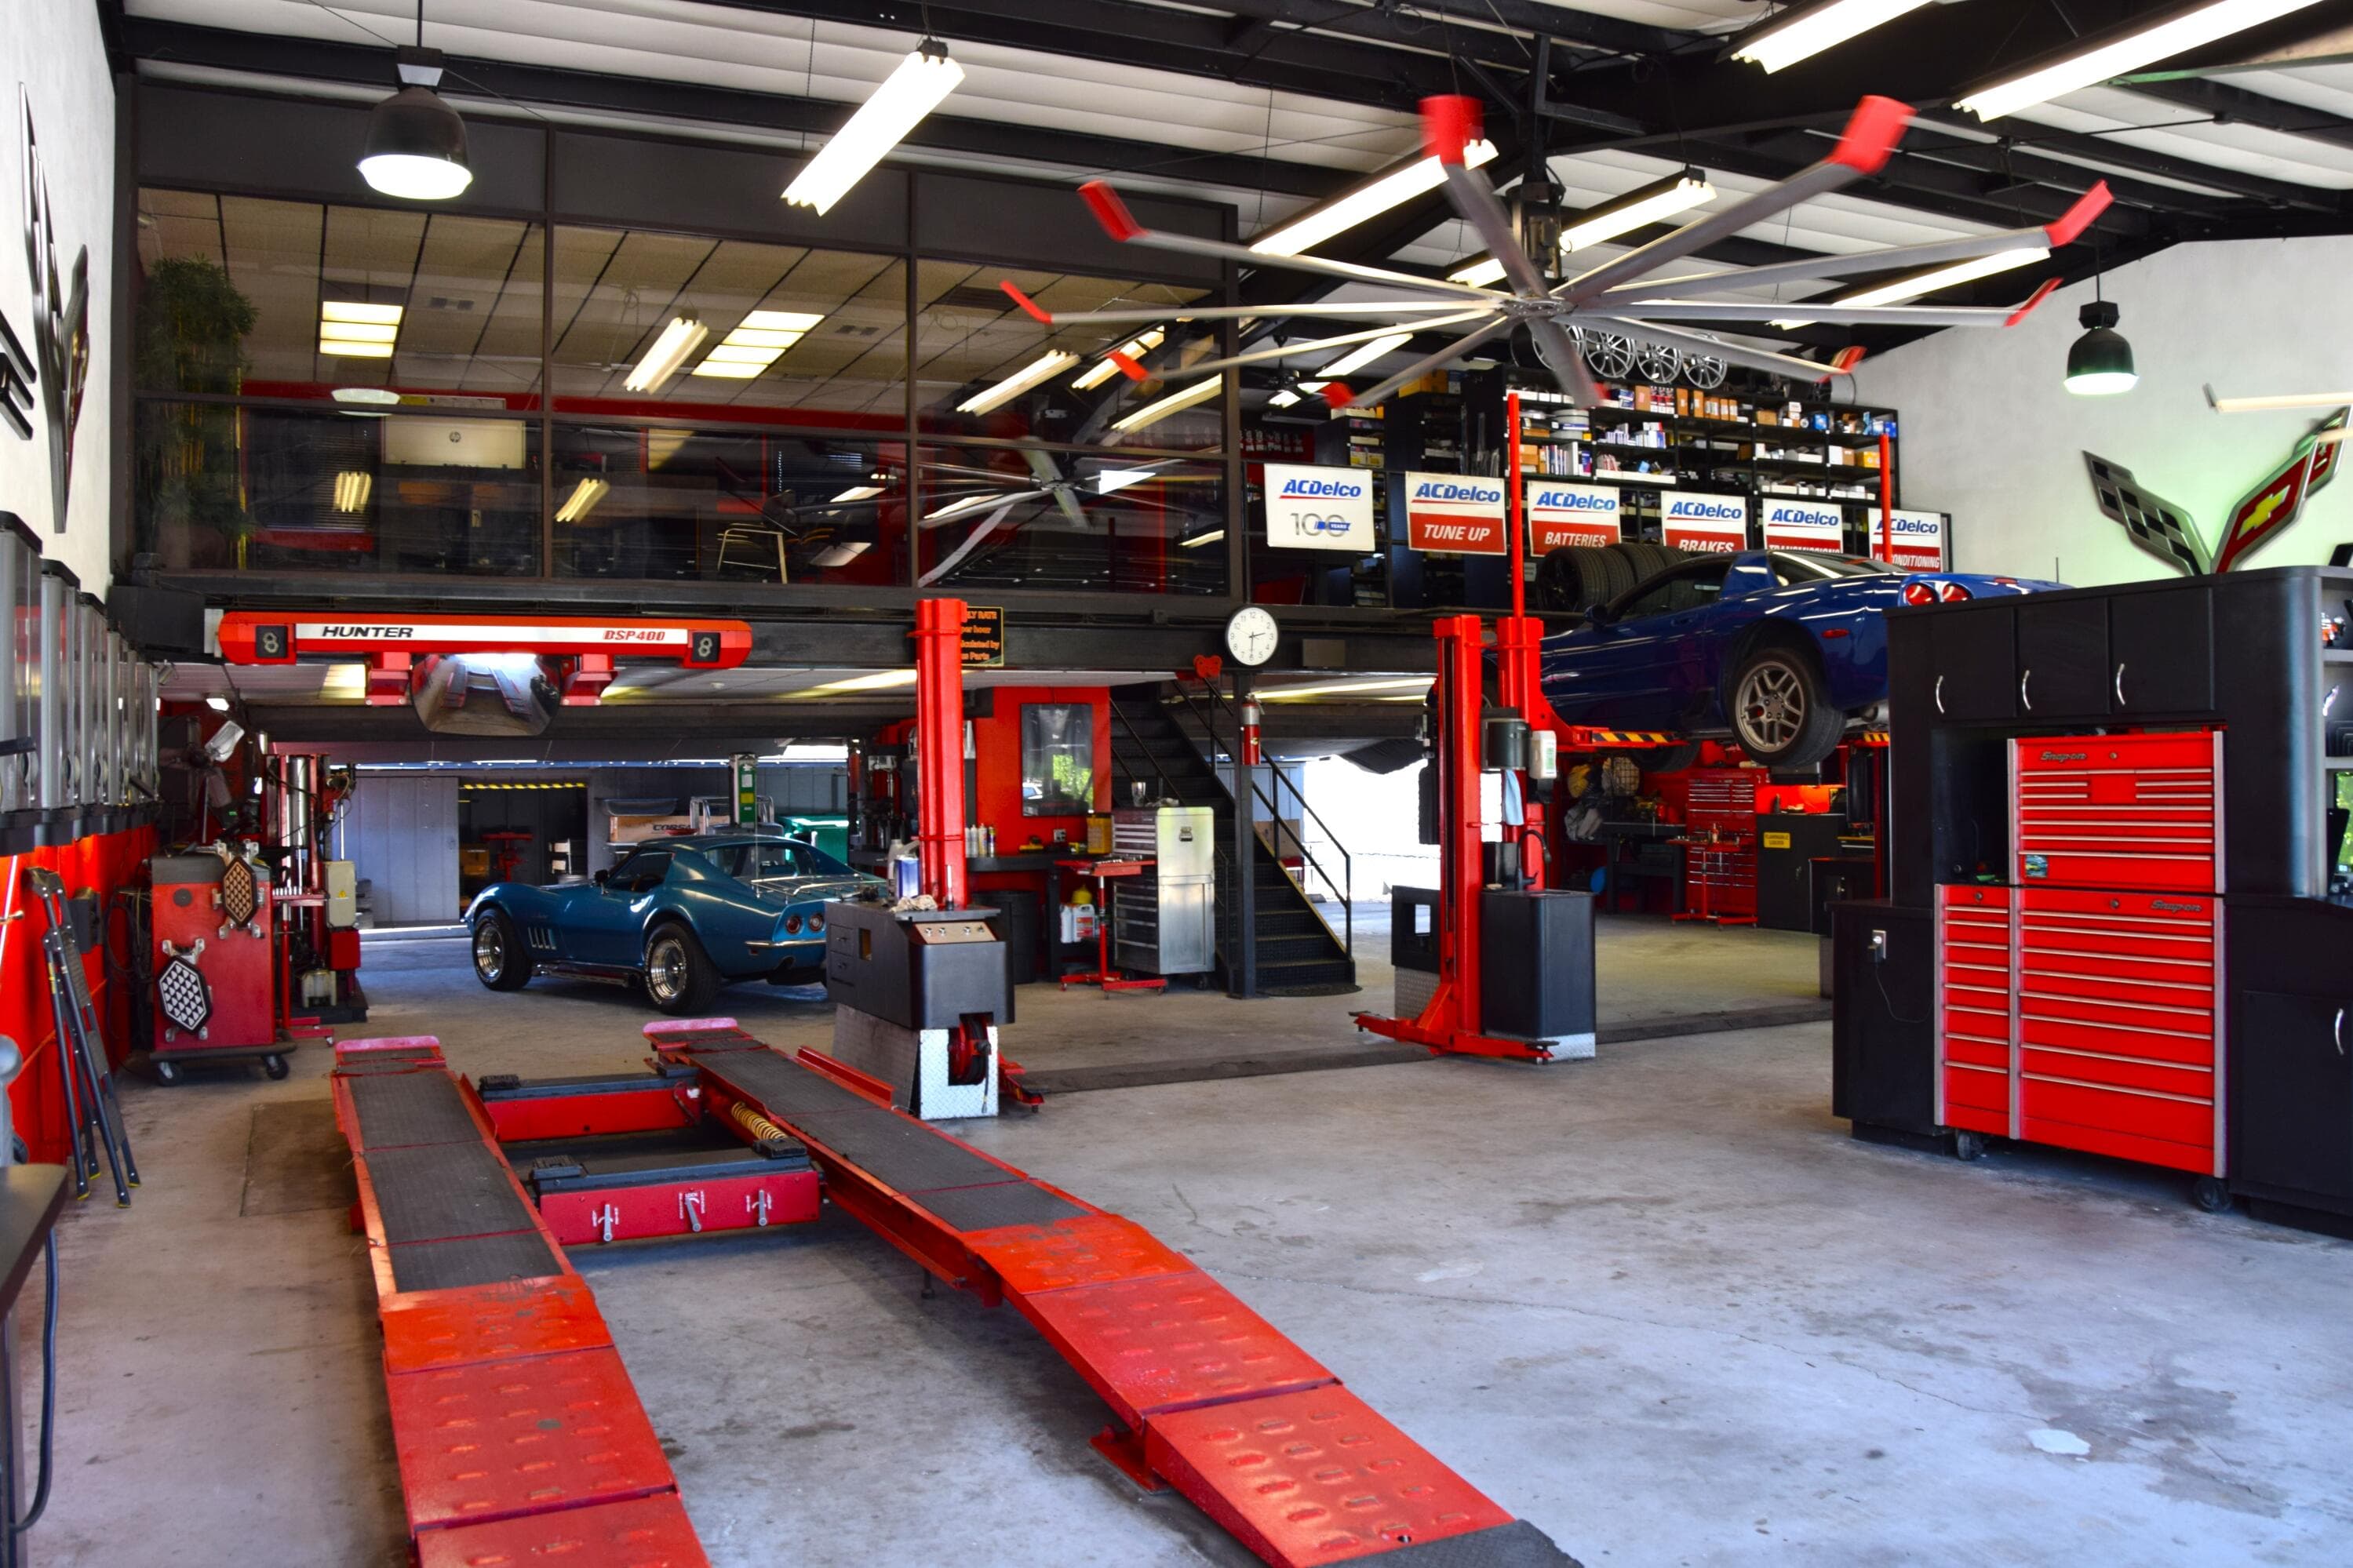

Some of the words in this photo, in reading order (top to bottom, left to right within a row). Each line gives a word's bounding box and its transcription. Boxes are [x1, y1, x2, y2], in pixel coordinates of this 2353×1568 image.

[1283, 479, 1361, 497] ACDelco
[1415, 483, 1500, 503] ACDelco
[1536, 492, 1615, 511] ACDelco
[1670, 501, 1743, 519] ACDelco
[1771, 508, 1839, 526] ACDelco
[1424, 524, 1465, 540] TUNE
[1467, 527, 1491, 541] UP
[1544, 532, 1608, 548] BATTERIES
[1678, 539, 1735, 552] BRAKES
[322, 626, 414, 638] HUNTER
[604, 630, 665, 641] DSP400
[2041, 751, 2087, 762] Snap-on
[2151, 900, 2202, 913] Snap-on
